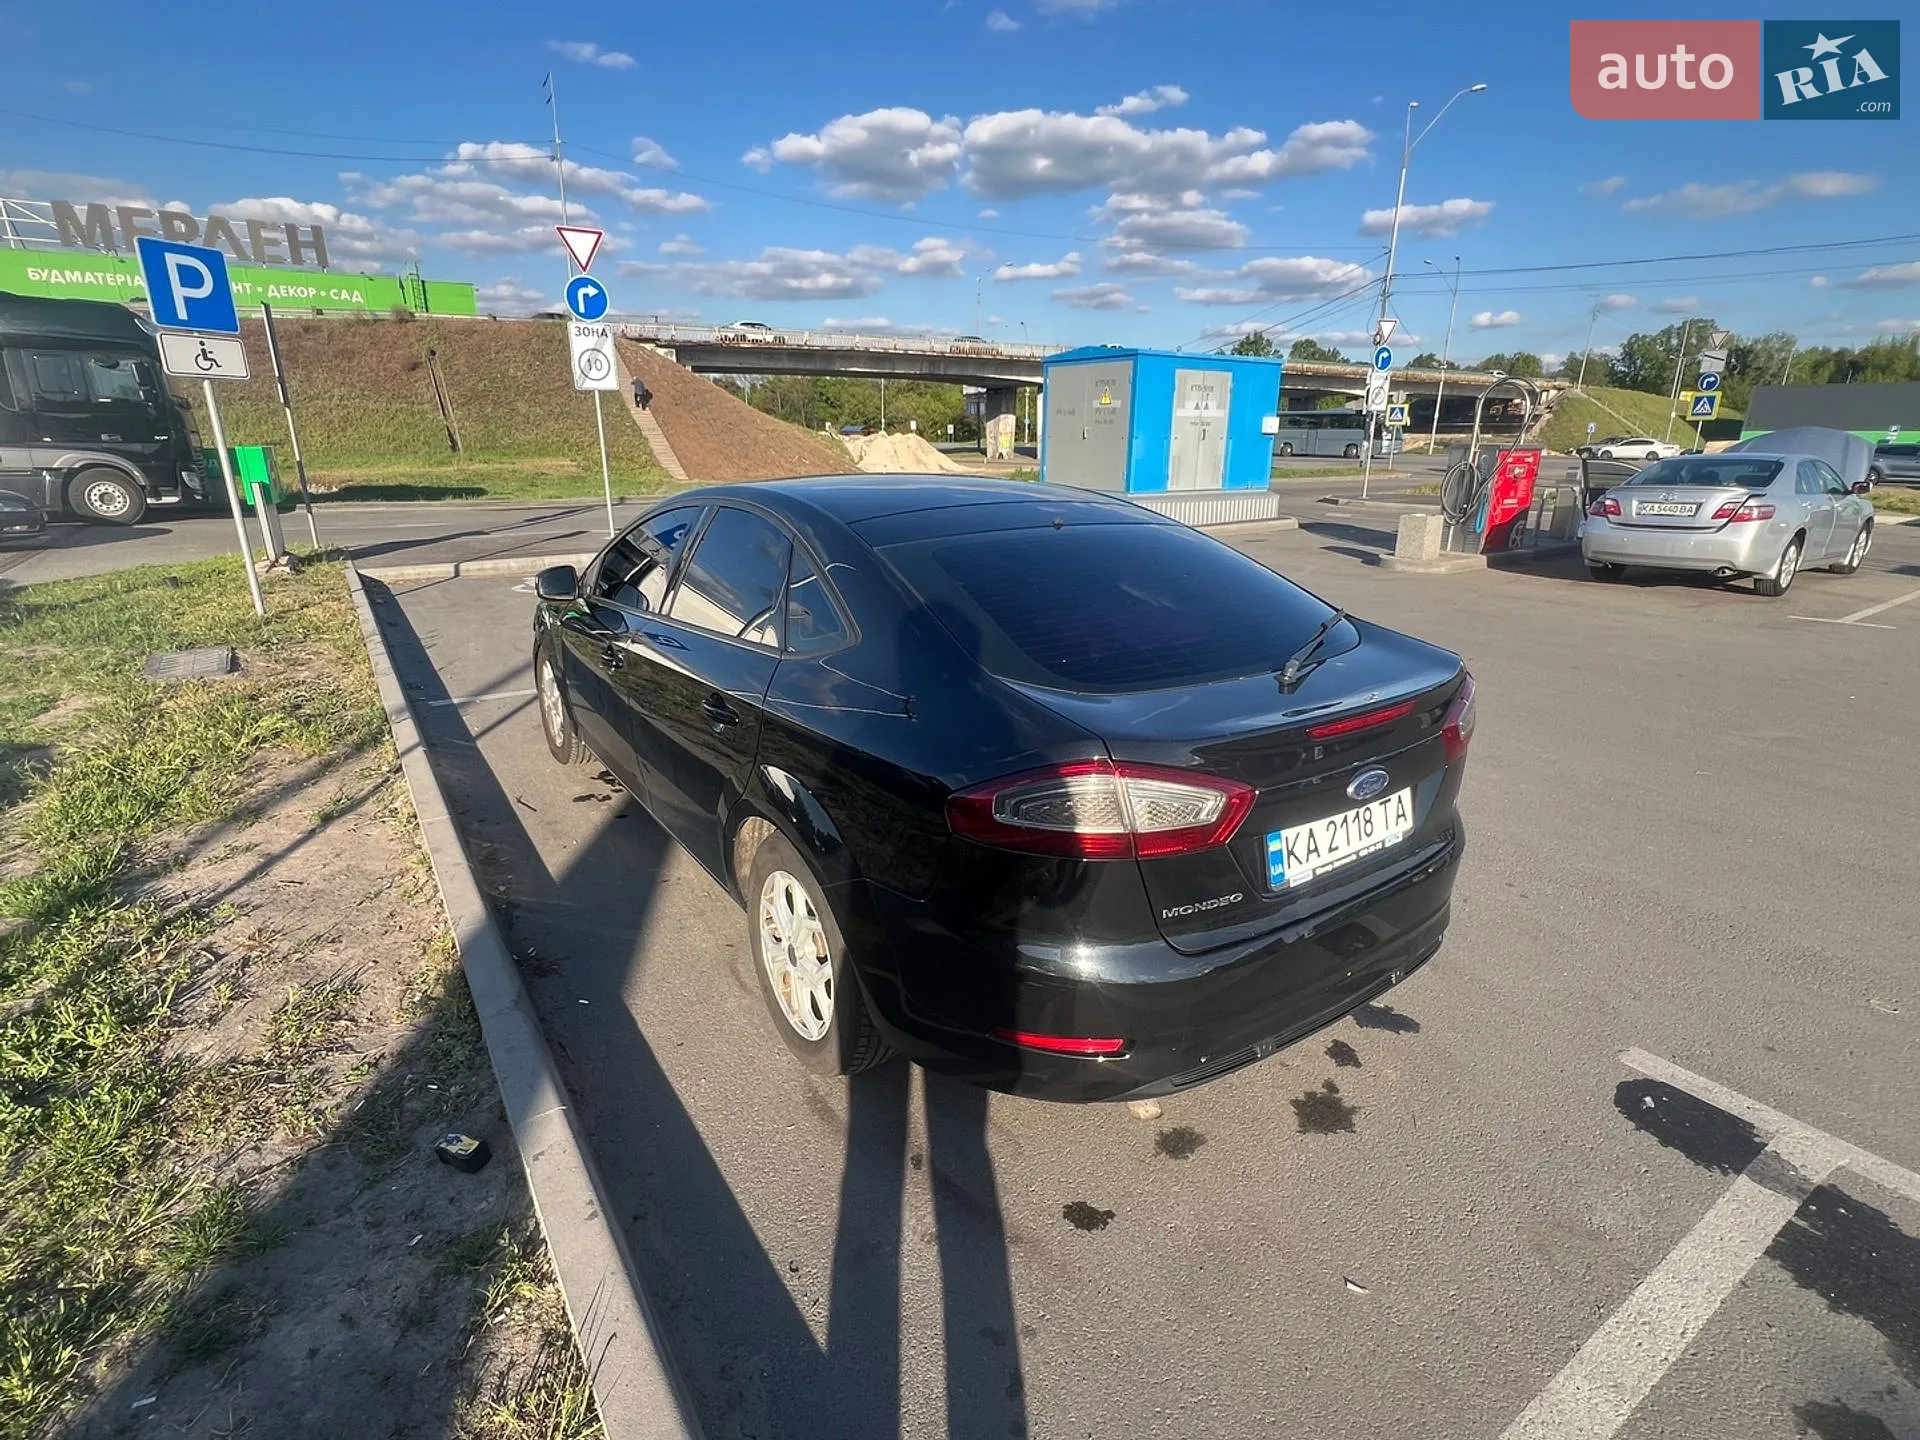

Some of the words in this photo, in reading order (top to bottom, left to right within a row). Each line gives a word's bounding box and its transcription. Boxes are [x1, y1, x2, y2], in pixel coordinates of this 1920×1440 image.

[26, 267, 148, 288] БУДМАТЕРІА
[267, 284, 317, 299] ДЕКОР
[329, 288, 364, 304] САД
[164, 251, 214, 321] P
[574, 325, 609, 339] ЗОНА
[1285, 827, 1321, 870] KA
[1326, 806, 1374, 854] 2118
[1379, 794, 1408, 831] TA
[1161, 892, 1244, 919] MONDEO
